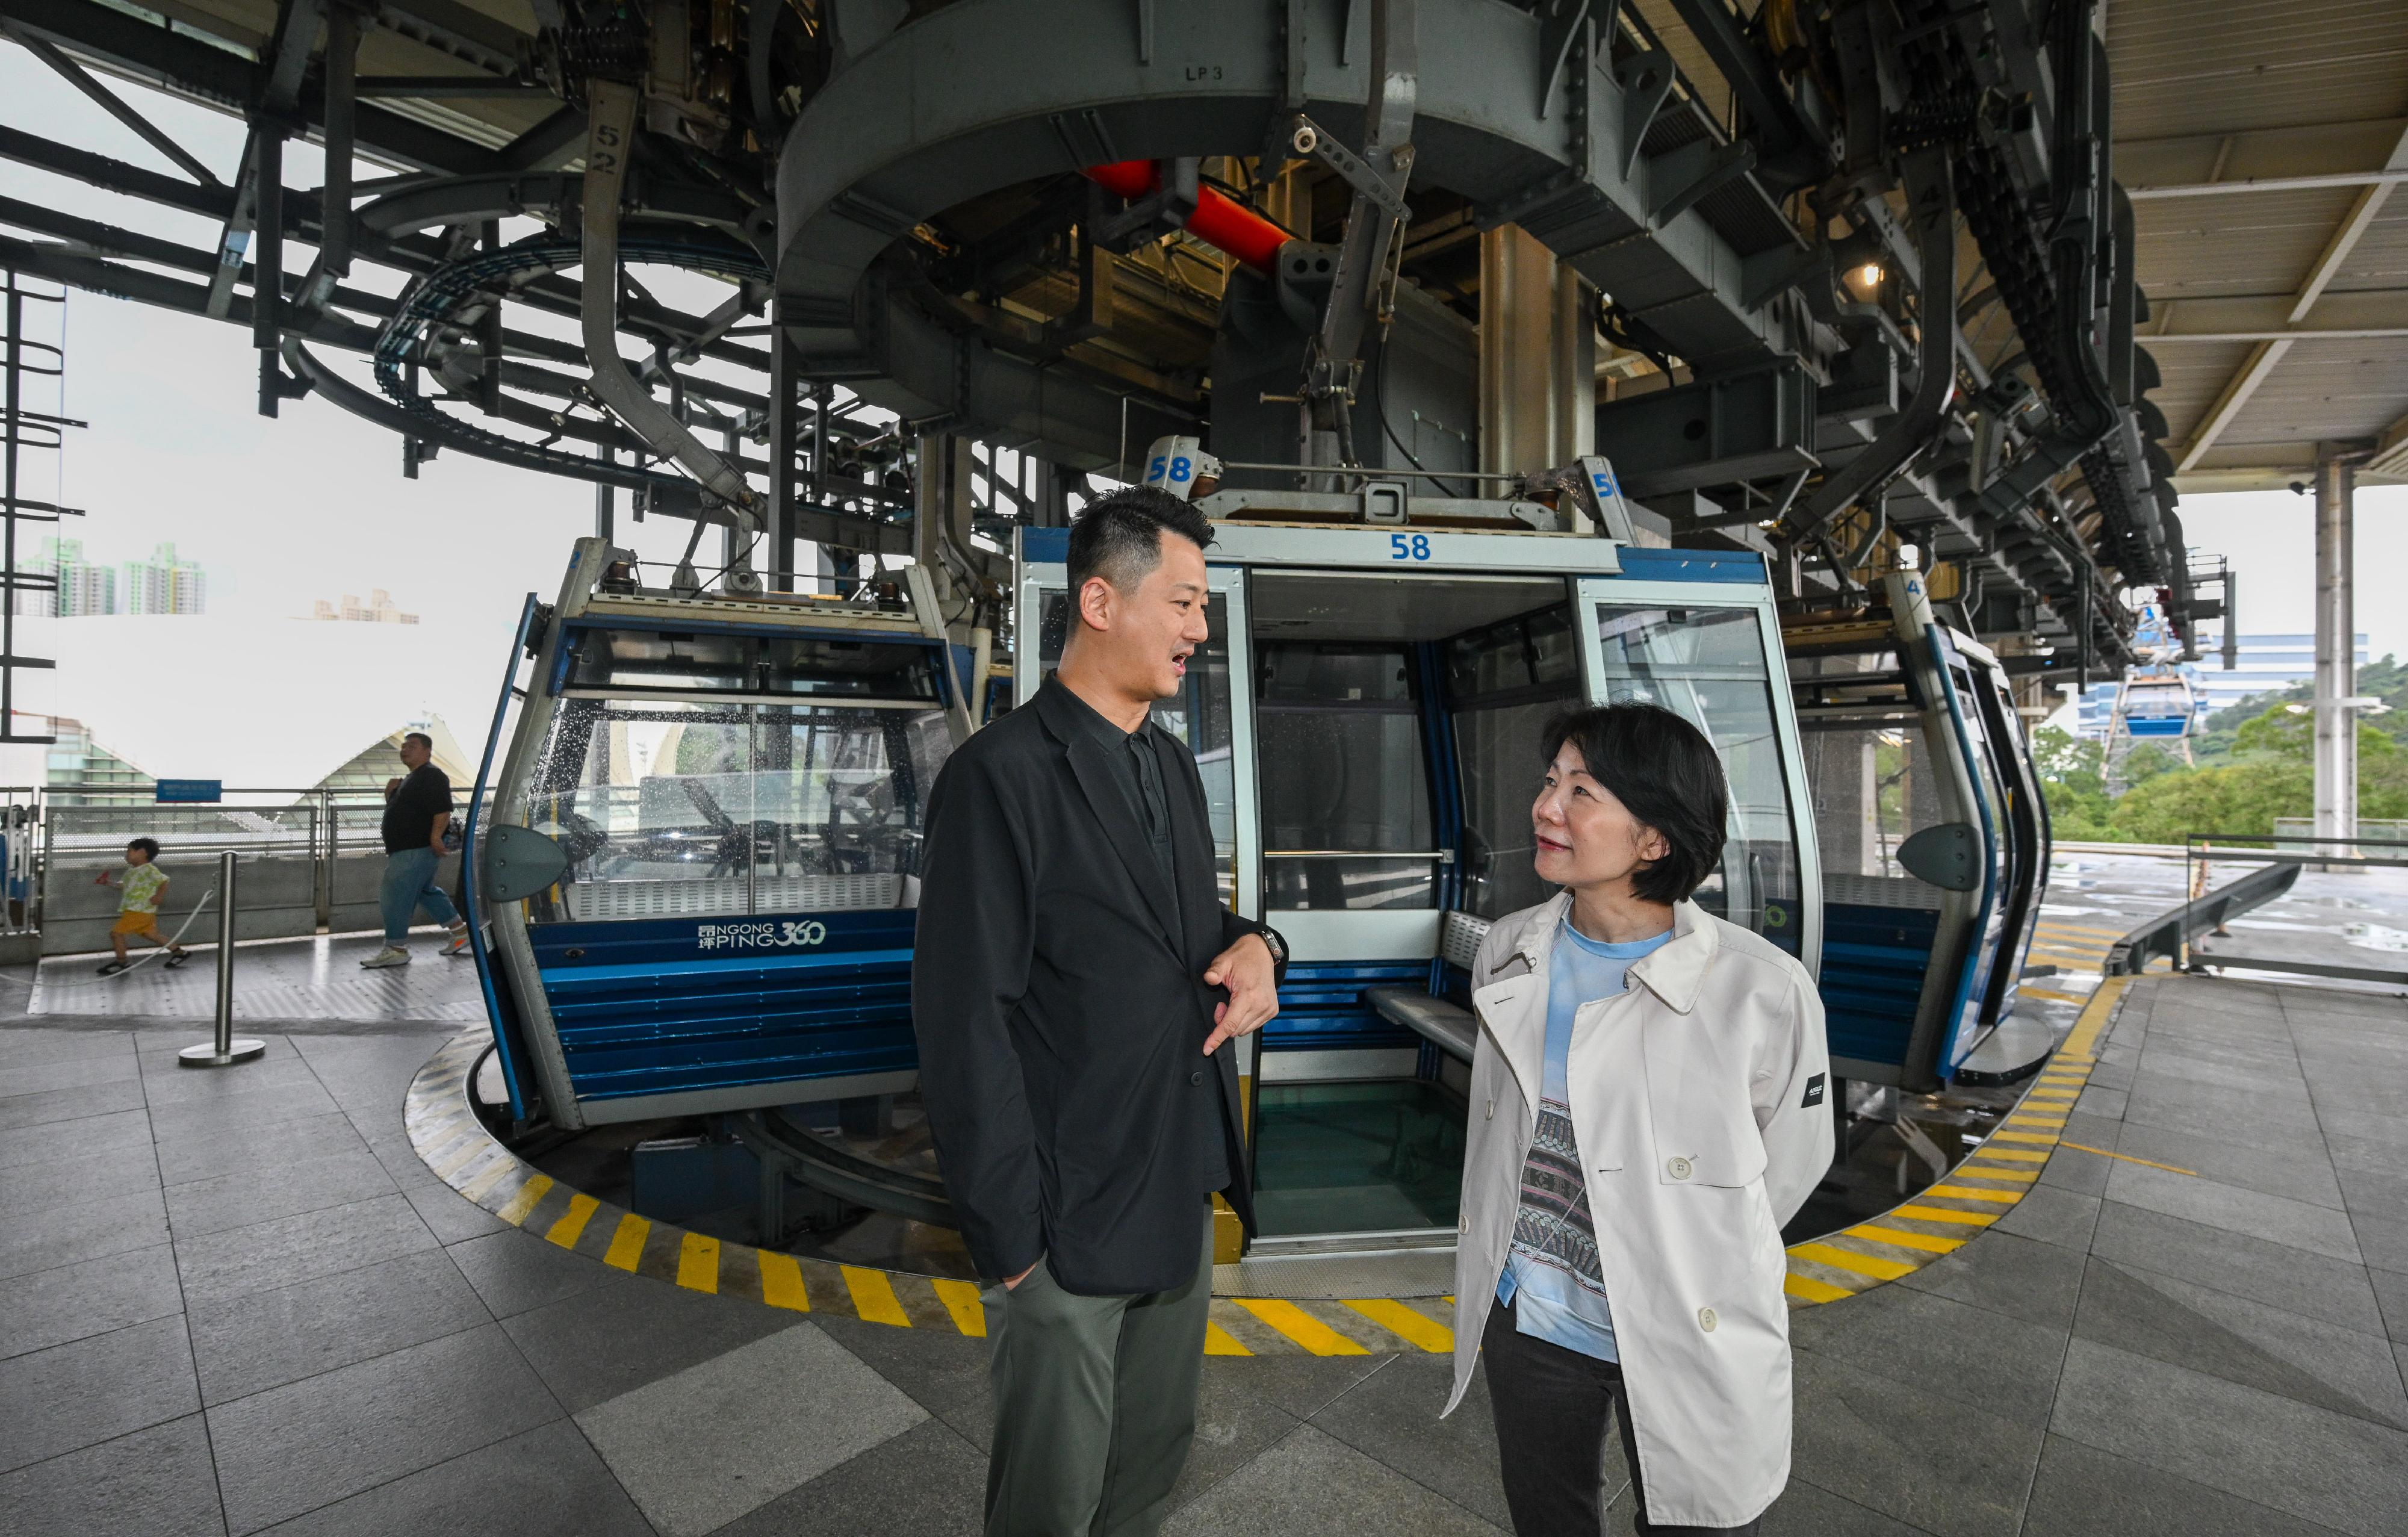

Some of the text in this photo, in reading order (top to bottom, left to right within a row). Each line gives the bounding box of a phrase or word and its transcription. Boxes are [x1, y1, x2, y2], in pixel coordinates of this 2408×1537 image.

[1185, 66, 1223, 81] LP 3
[1148, 456, 1191, 482] 58
[1391, 534, 1431, 560] 58
[716, 924, 774, 935] NGONG
[716, 920, 827, 949] PING 360
